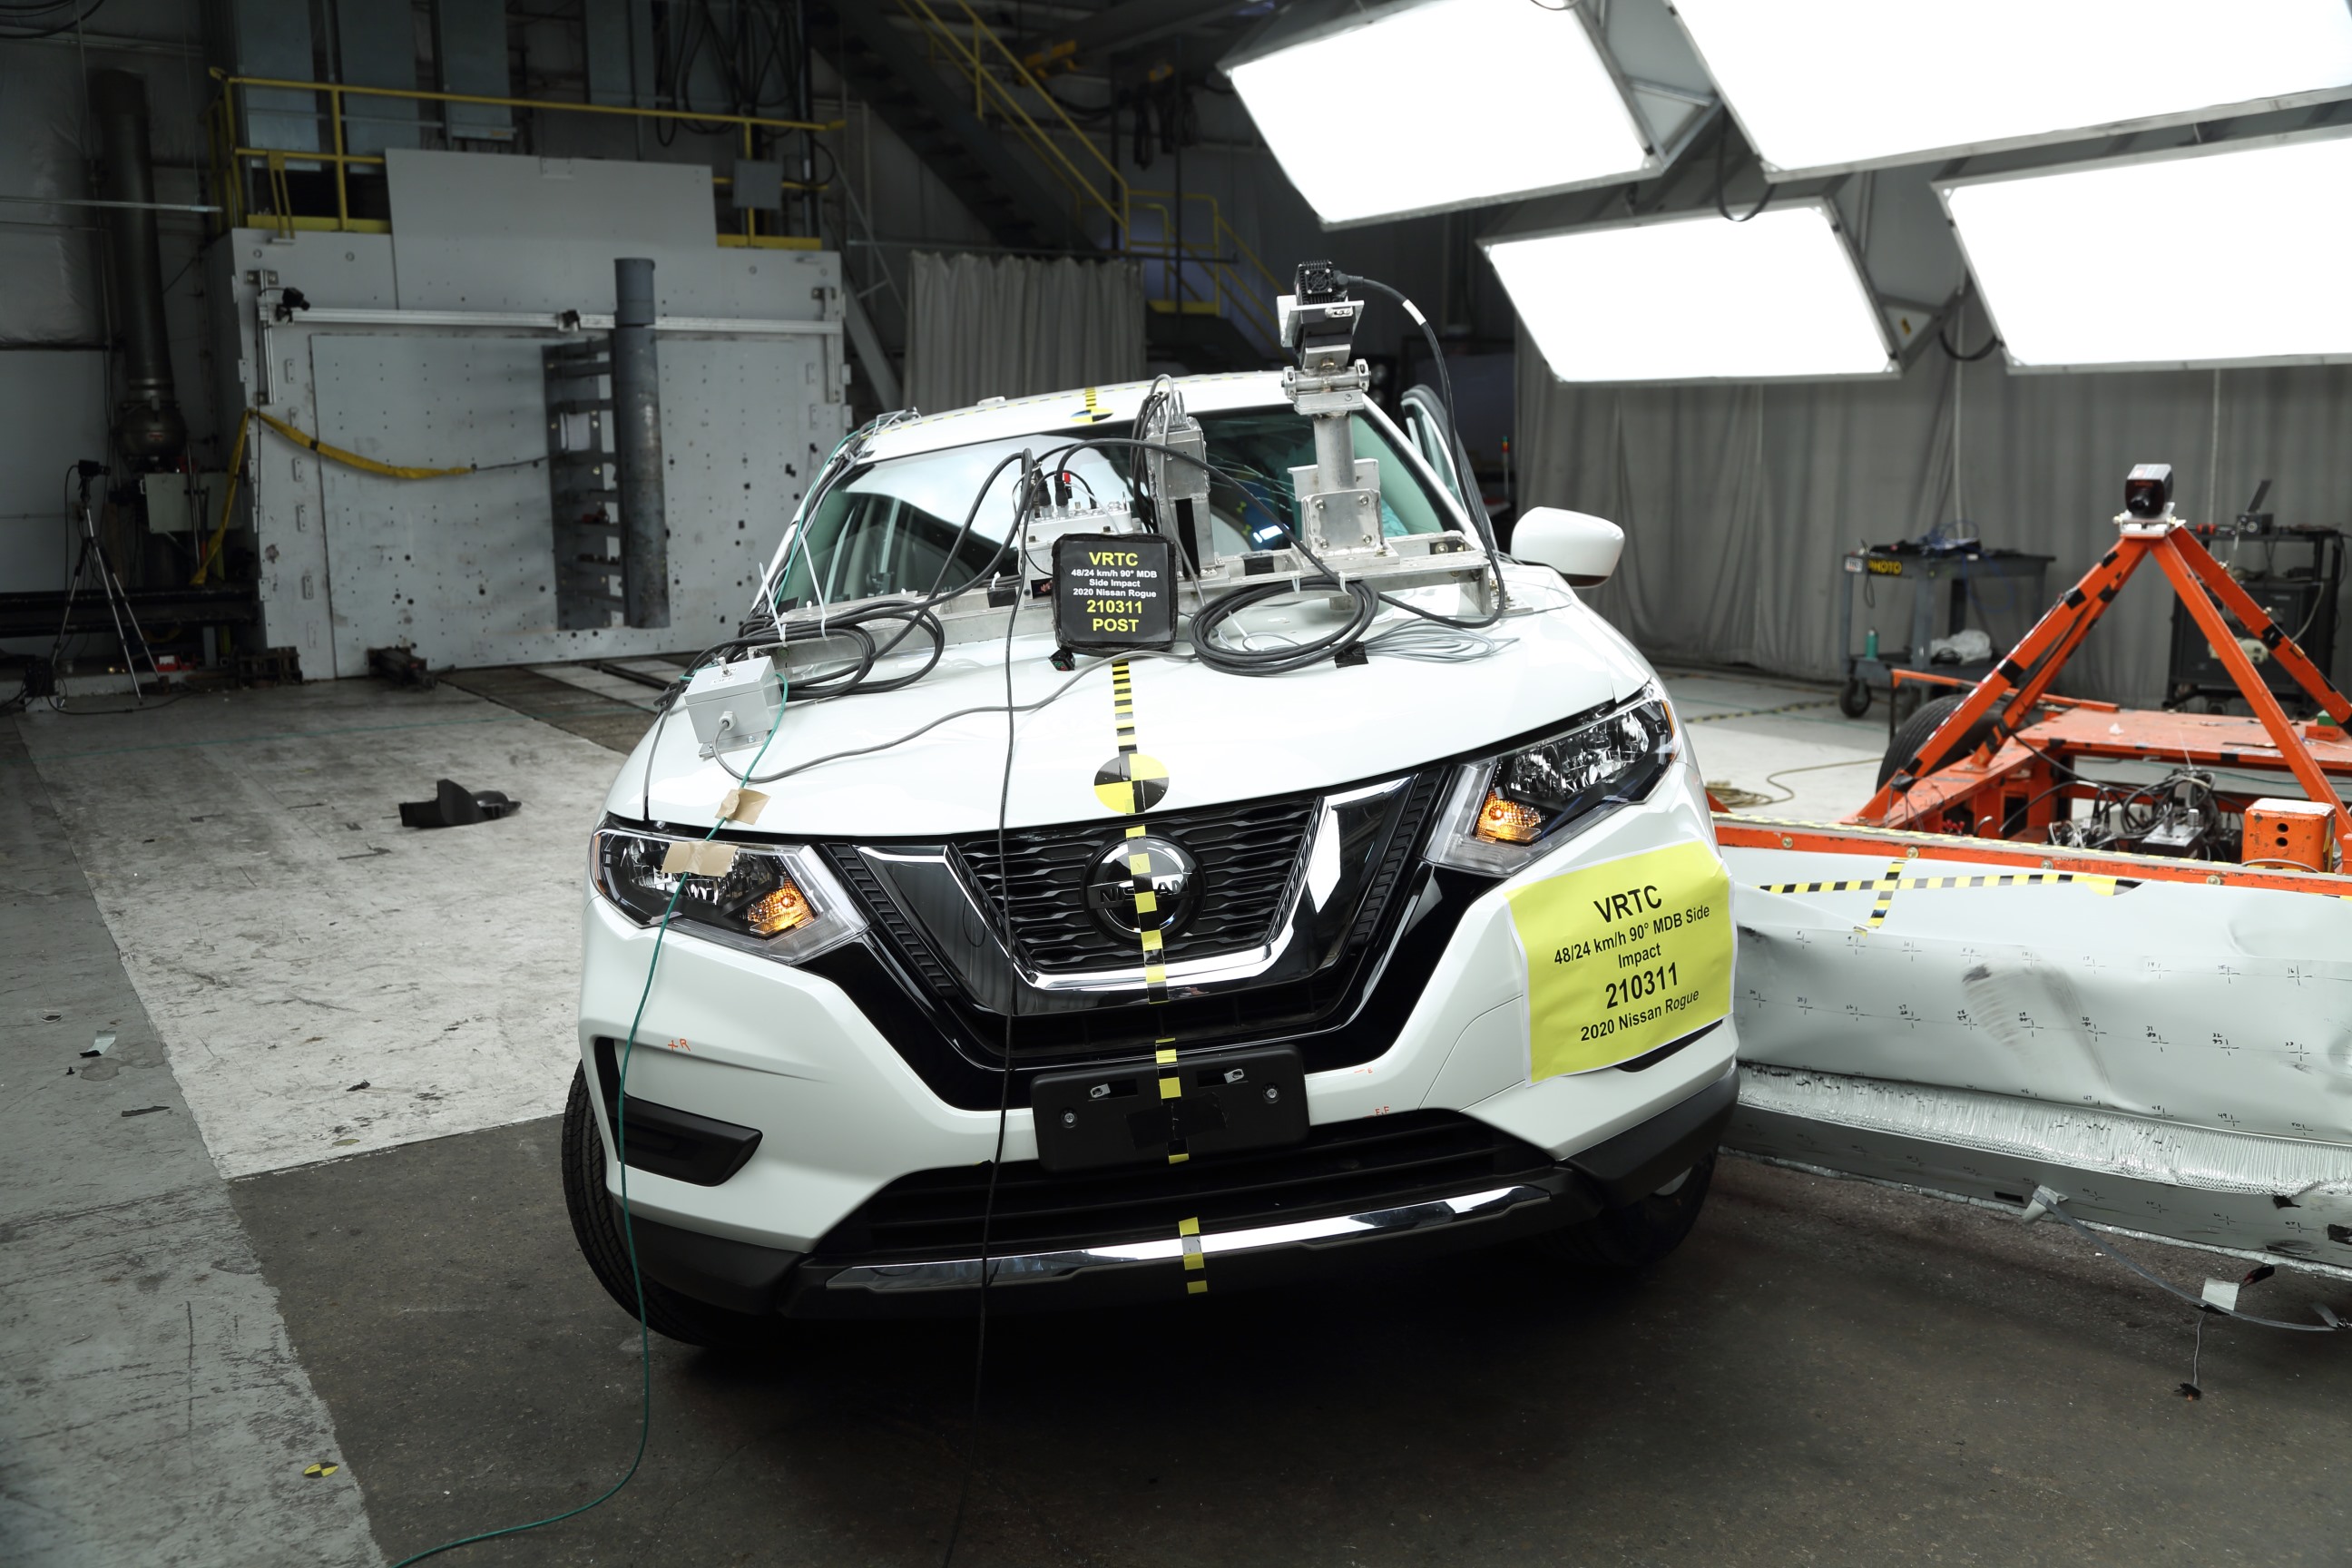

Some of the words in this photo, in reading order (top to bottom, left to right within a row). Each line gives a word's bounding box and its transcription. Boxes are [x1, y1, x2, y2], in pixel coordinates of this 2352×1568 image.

[1089, 552, 1138, 566] VRTC
[1071, 569, 1094, 577] 48/24
[1120, 570, 1134, 578] 90°
[1089, 578, 1109, 586] Side
[1111, 579, 1141, 588] Impact
[1073, 588, 1093, 596] 2020
[1096, 589, 1126, 597] Nissan
[1128, 590, 1157, 599] Rogue
[1086, 600, 1142, 614] 210311
[1093, 618, 1139, 632] POST
[1099, 878, 1187, 904] NISAN
[1593, 885, 1662, 923] VRTC
[1554, 943, 1591, 965] 48/24
[1593, 931, 1626, 954] km/h
[1629, 922, 1650, 941] 90°
[1653, 913, 1683, 935] MDB
[1686, 905, 1710, 924] Side
[1618, 943, 1661, 968] Impact
[1605, 962, 1678, 1009] 210311
[1581, 1018, 1615, 1042] 2020
[1619, 1006, 1662, 1030] Nissan
[1665, 990, 1700, 1014] Rogue
